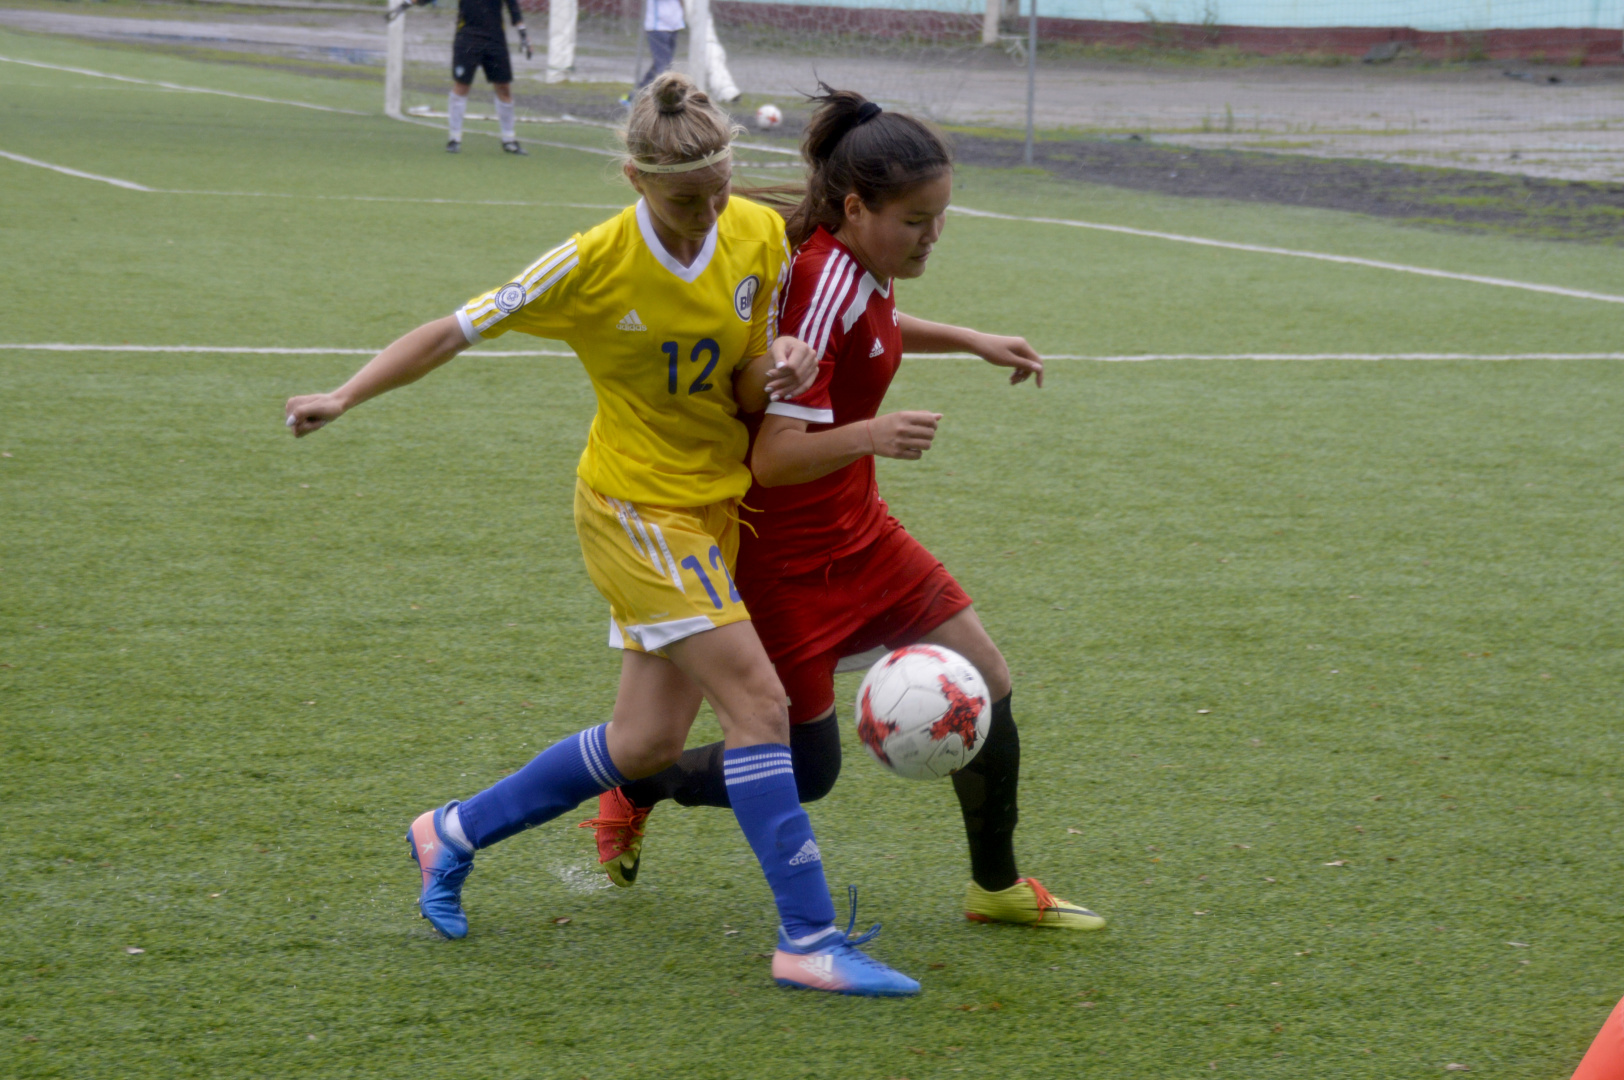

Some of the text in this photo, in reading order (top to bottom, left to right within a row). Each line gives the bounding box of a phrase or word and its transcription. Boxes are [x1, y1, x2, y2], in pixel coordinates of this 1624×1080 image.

[616, 323, 648, 332] adidas
[661, 338, 720, 396] 12
[681, 544, 742, 610] 12
